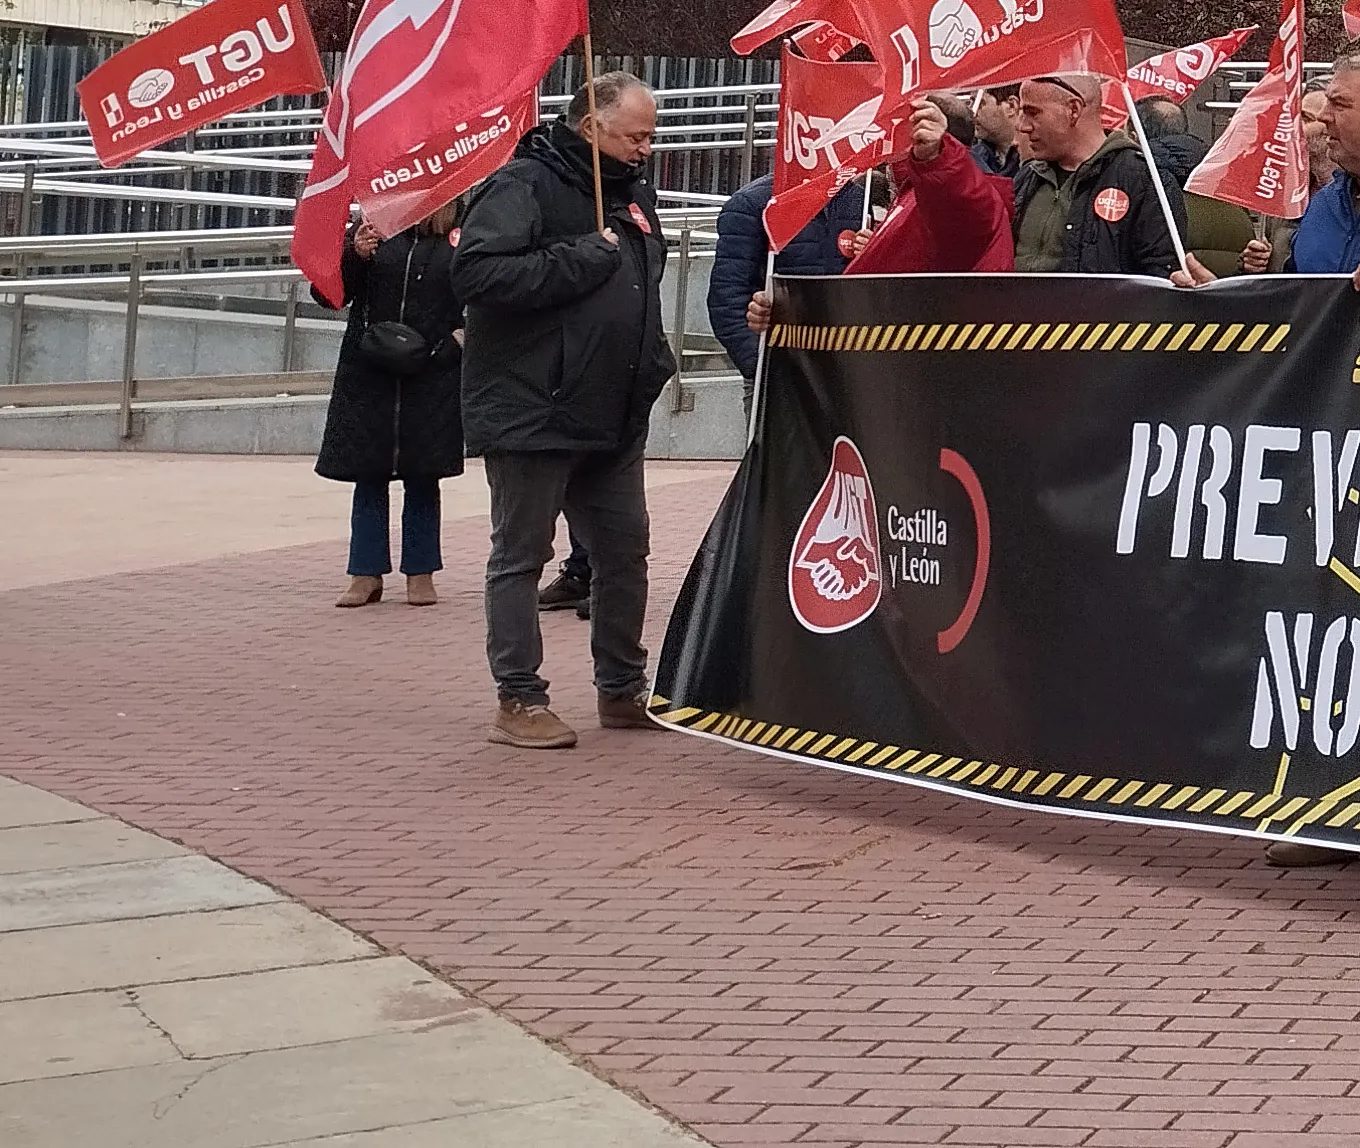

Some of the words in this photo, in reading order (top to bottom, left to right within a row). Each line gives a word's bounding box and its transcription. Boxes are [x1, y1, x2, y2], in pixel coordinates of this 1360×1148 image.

[887, 505, 948, 546] Castilla
[889, 554, 898, 589] y
[901, 546, 940, 586] León
